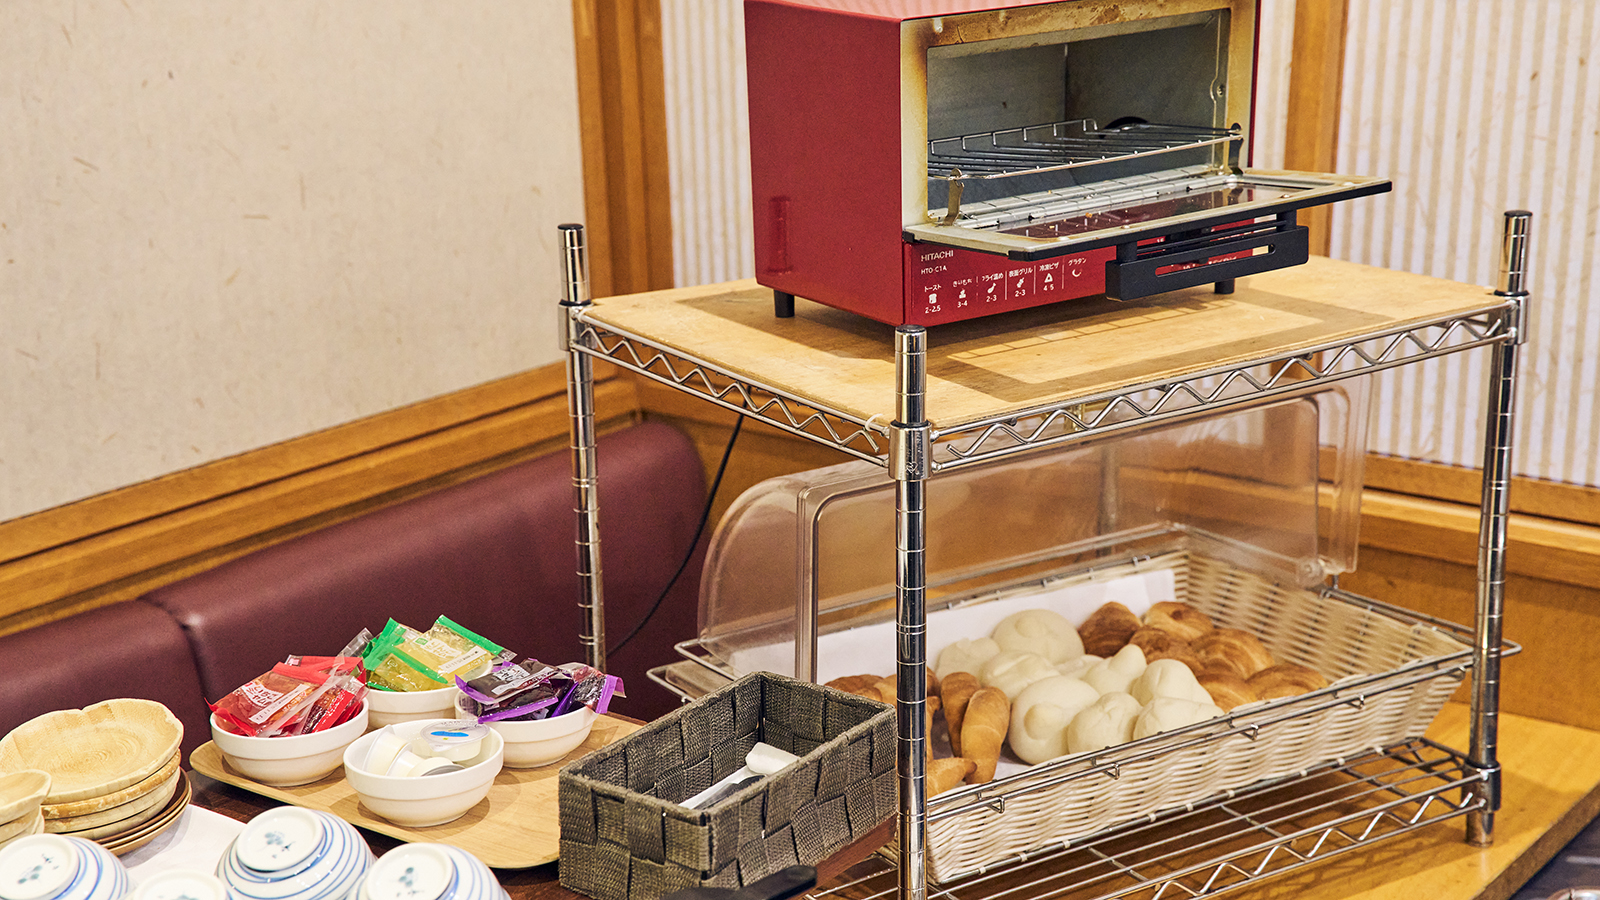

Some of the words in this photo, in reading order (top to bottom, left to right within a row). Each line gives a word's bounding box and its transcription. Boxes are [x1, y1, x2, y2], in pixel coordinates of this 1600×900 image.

[921, 250, 954, 262] HITACHI
[1068, 257, 1087, 266] グラタン
[920, 265, 947, 275] HTOC1A
[924, 283, 942, 293] トースト
